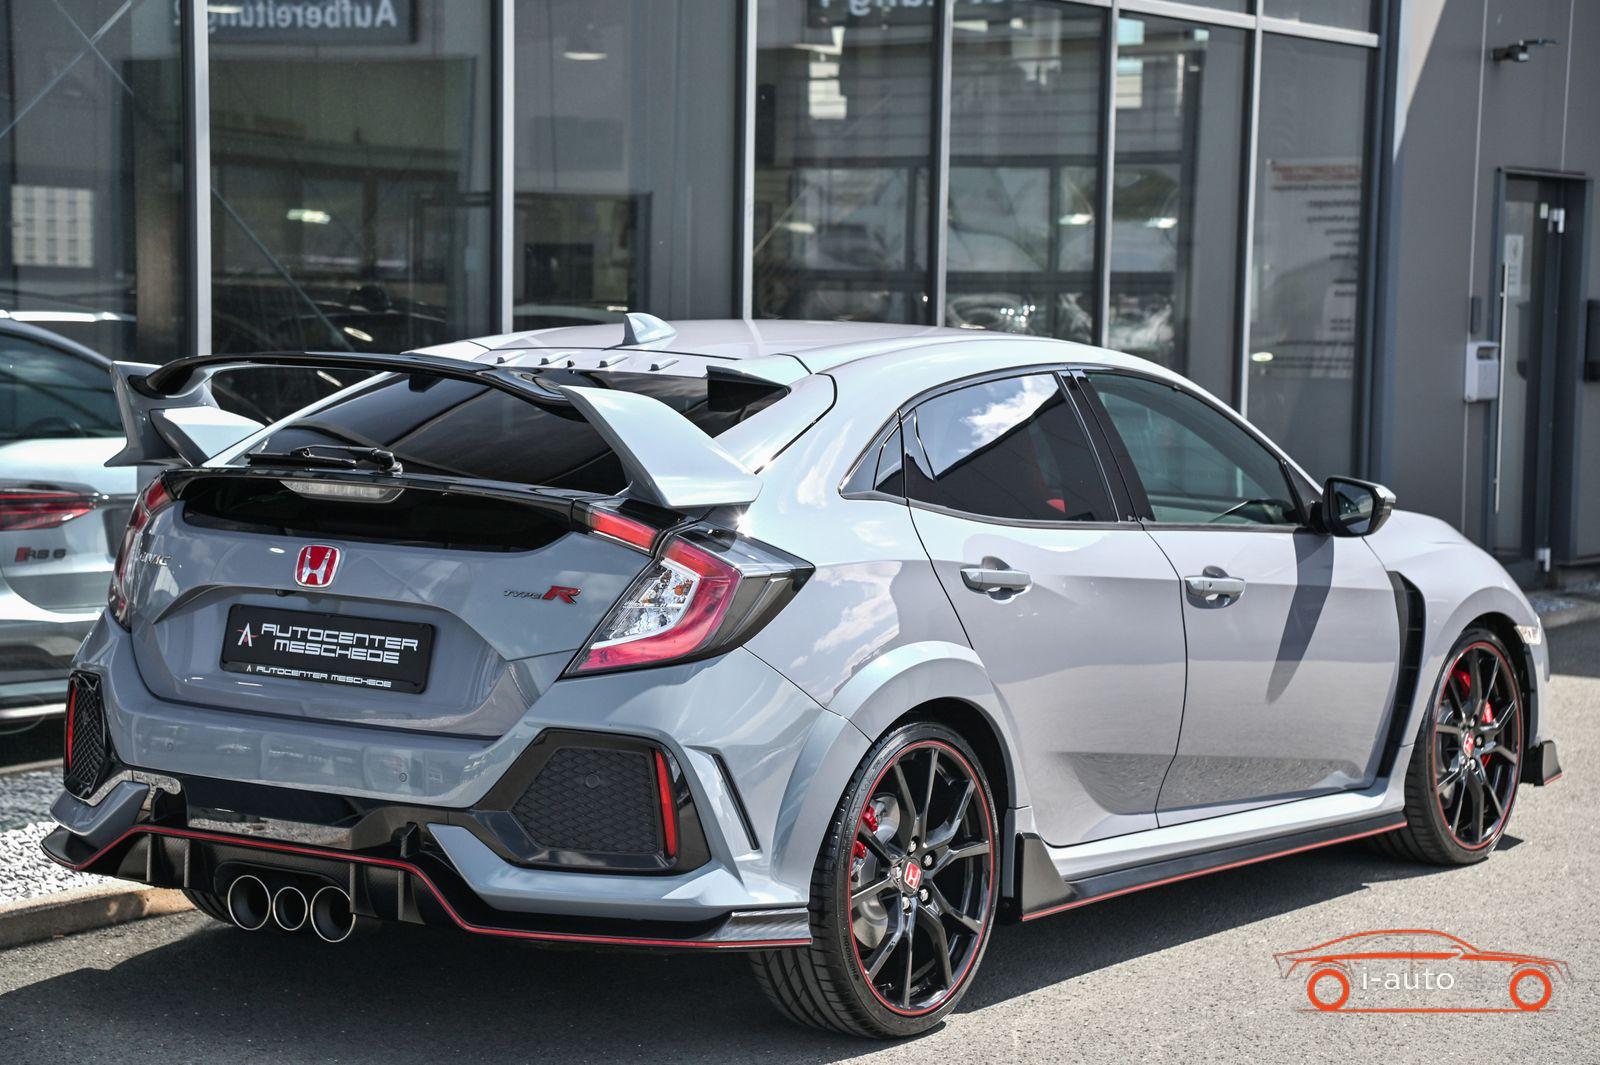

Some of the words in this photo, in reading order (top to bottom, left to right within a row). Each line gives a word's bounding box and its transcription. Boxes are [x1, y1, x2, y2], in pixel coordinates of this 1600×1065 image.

[504, 589, 543, 600] TYPE
[542, 585, 581, 604] R
[261, 623, 419, 651] AUTOCENTER
[274, 638, 400, 664] MESCHEDE
[256, 665, 328, 680] AUTOCENTER
[330, 673, 392, 688] MESCHEDE
